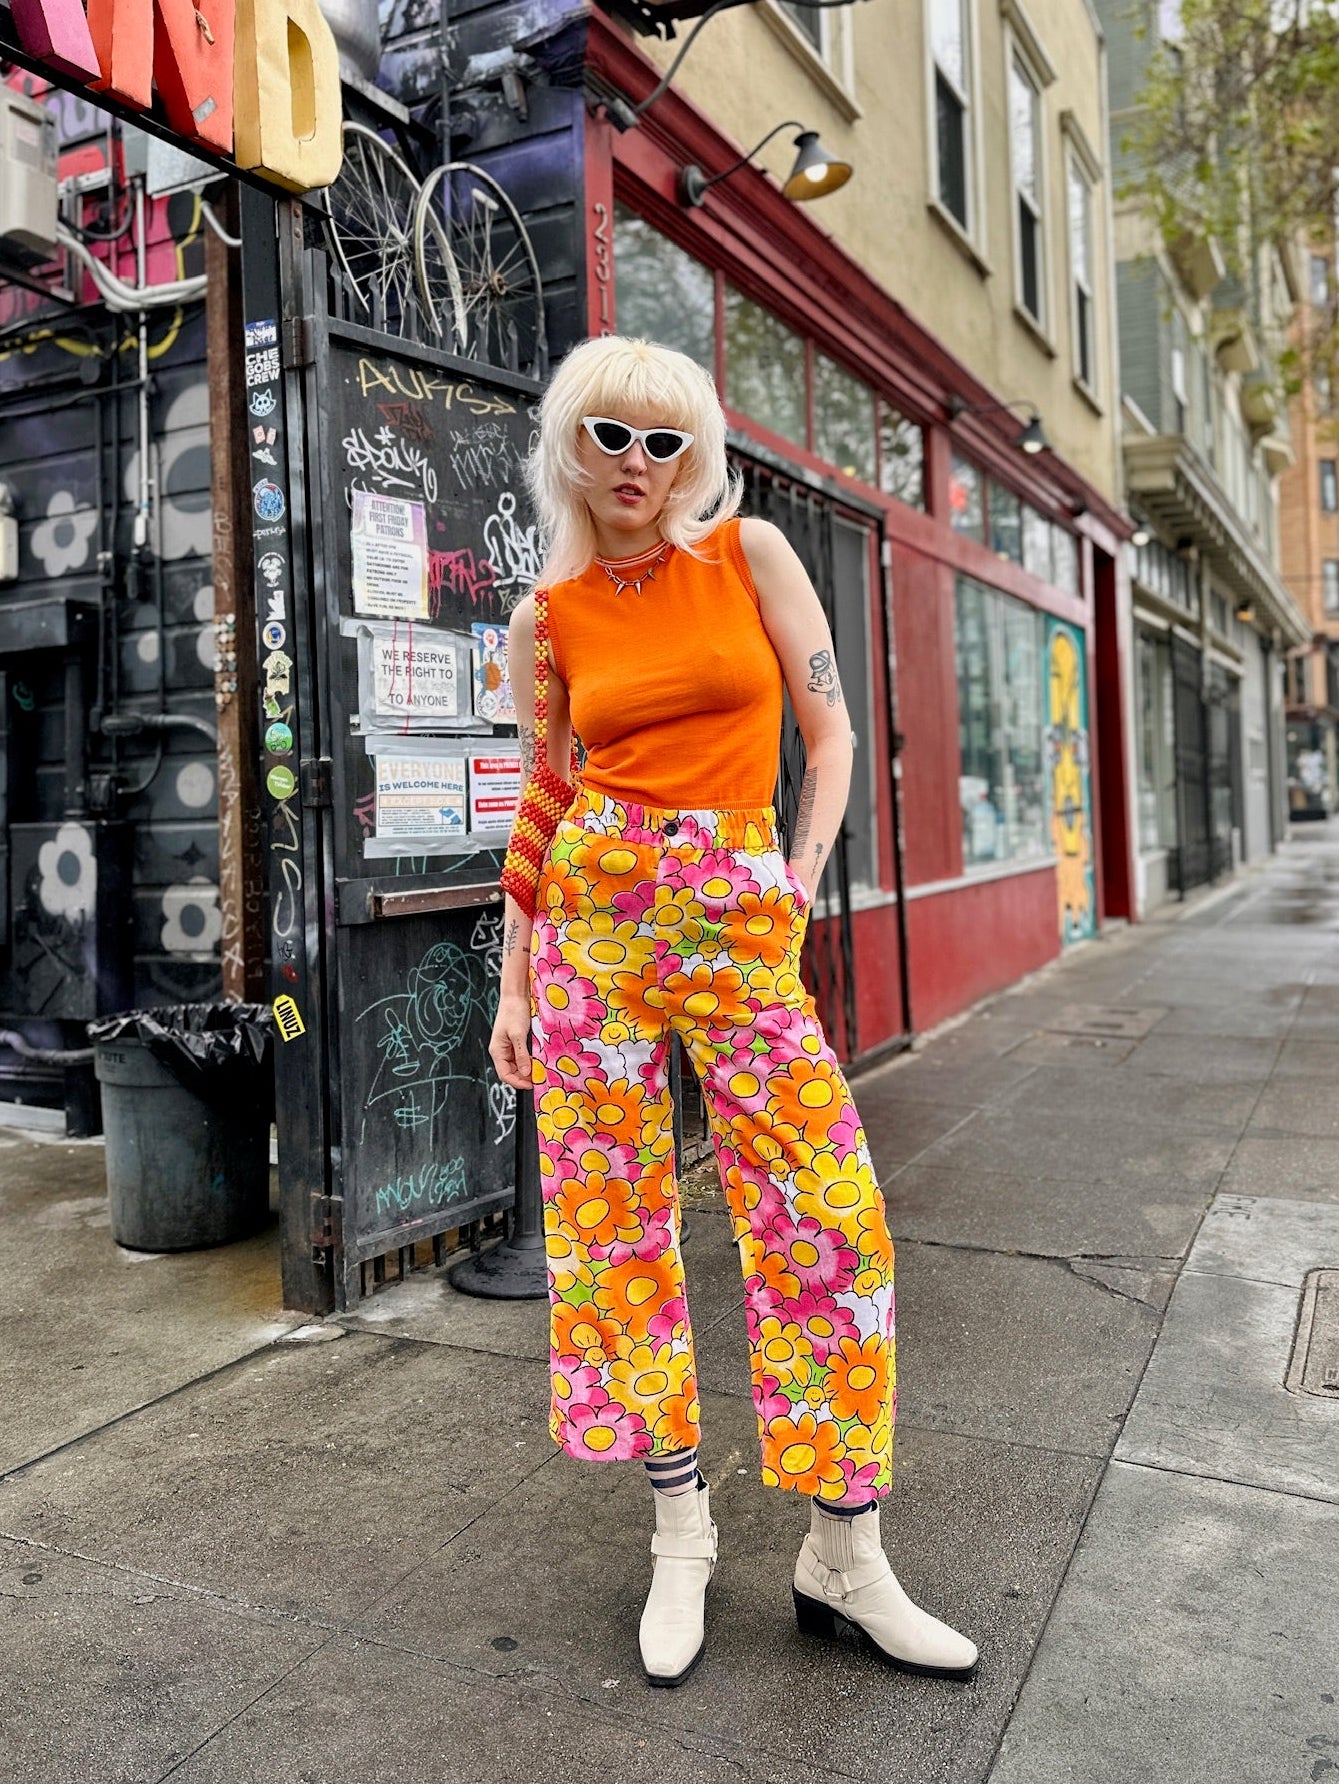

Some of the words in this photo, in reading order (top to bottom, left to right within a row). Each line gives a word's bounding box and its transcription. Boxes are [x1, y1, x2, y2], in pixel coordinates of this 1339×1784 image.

[593, 202, 611, 338] 231
[246, 368, 281, 387] CREW
[369, 511, 386, 524] FIRST
[388, 514, 409, 528] FRIDAY
[376, 523, 404, 538] PATRONS
[382, 649, 399, 661] WE
[402, 651, 451, 665] RESERVE
[382, 664, 402, 677] THE
[405, 666, 436, 678] RIGHT
[440, 668, 453, 680] TO
[389, 693, 403, 706] TO
[407, 694, 448, 707] ANYONE
[378, 761, 464, 782] EVERYONE
[379, 783, 391, 792] IS
[392, 781, 440, 790] WELCOME
[441, 782, 464, 792] HERE
[275, 1000, 301, 1038] LINUZ
